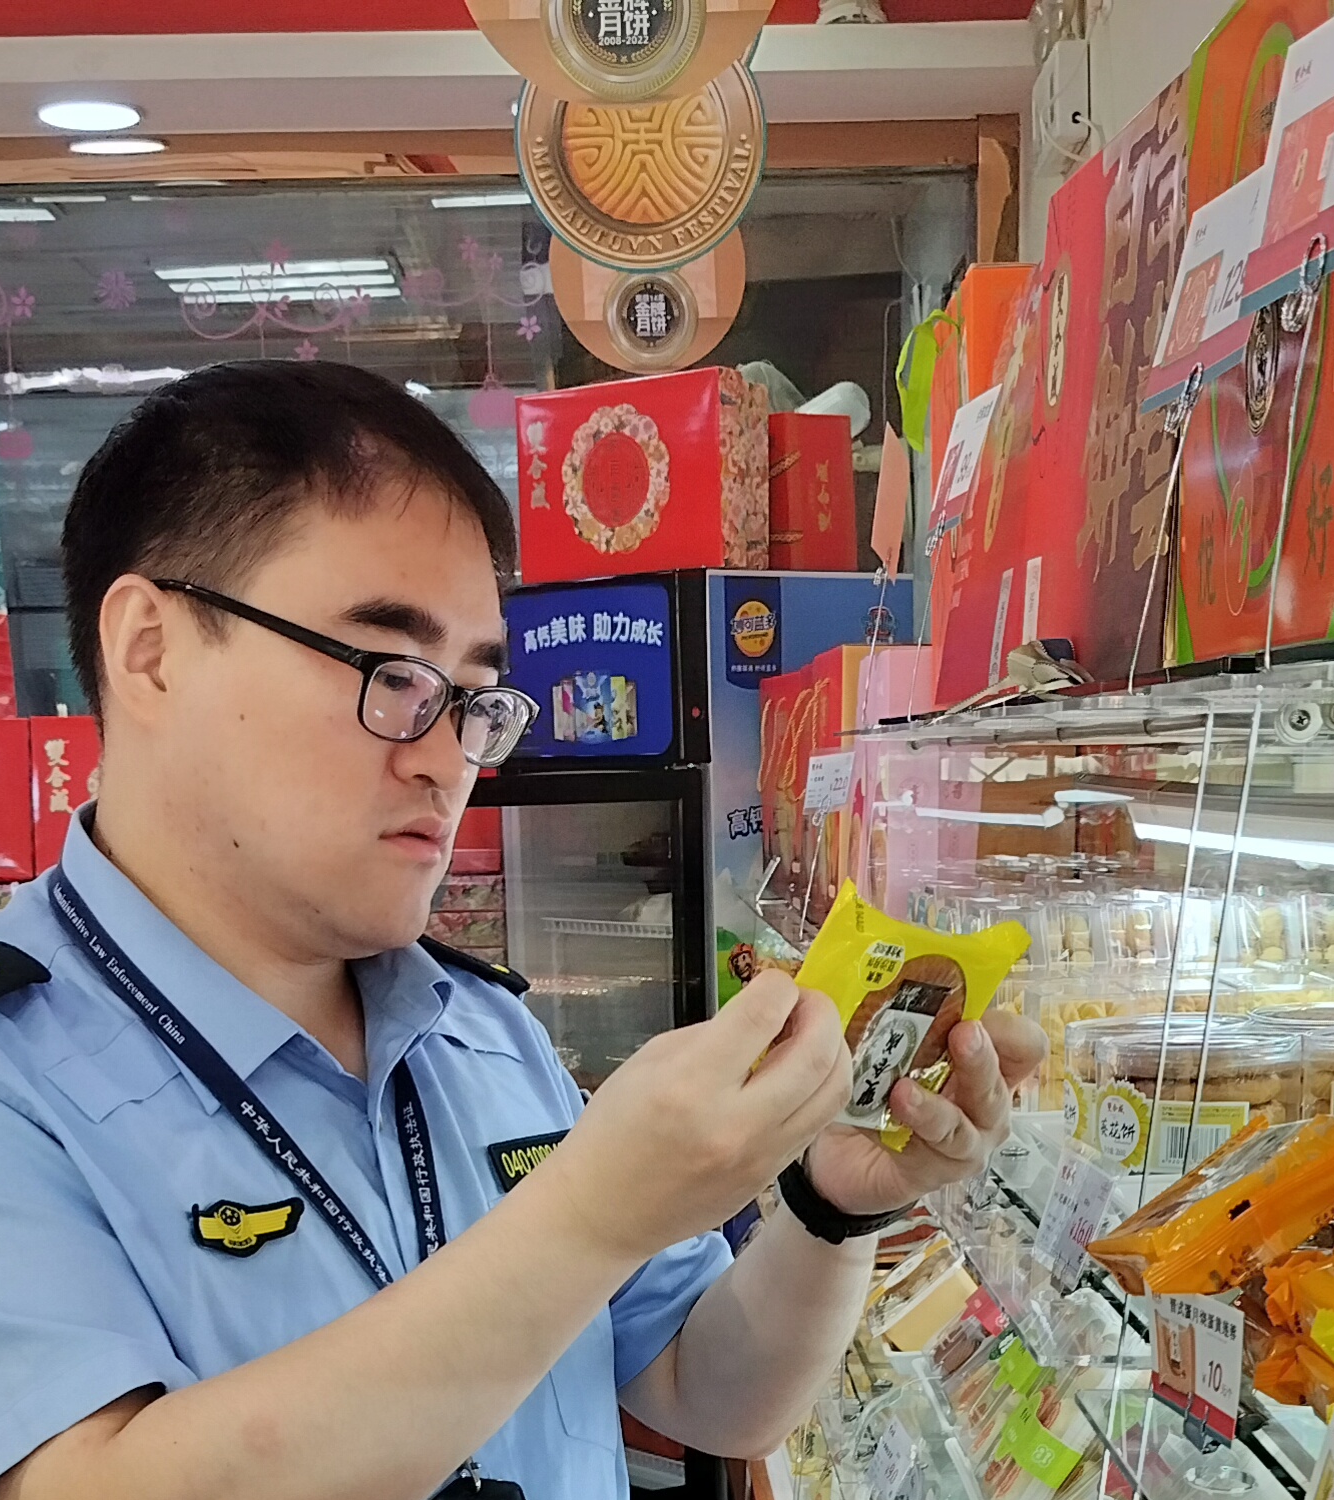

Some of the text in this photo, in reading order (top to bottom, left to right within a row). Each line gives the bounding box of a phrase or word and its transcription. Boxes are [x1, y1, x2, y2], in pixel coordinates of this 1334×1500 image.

[598, 11, 650, 37] 月饼
[598, 35, 649, 46] 2008-2022
[670, 141, 753, 246] FESTIVAL
[524, 611, 663, 655] 高钙美味 助力成长
[89, 936, 107, 959] Law
[106, 957, 160, 1016] Enforcement
[158, 1014, 187, 1045] China
[1100, 1119, 1136, 1142] 葵花饼
